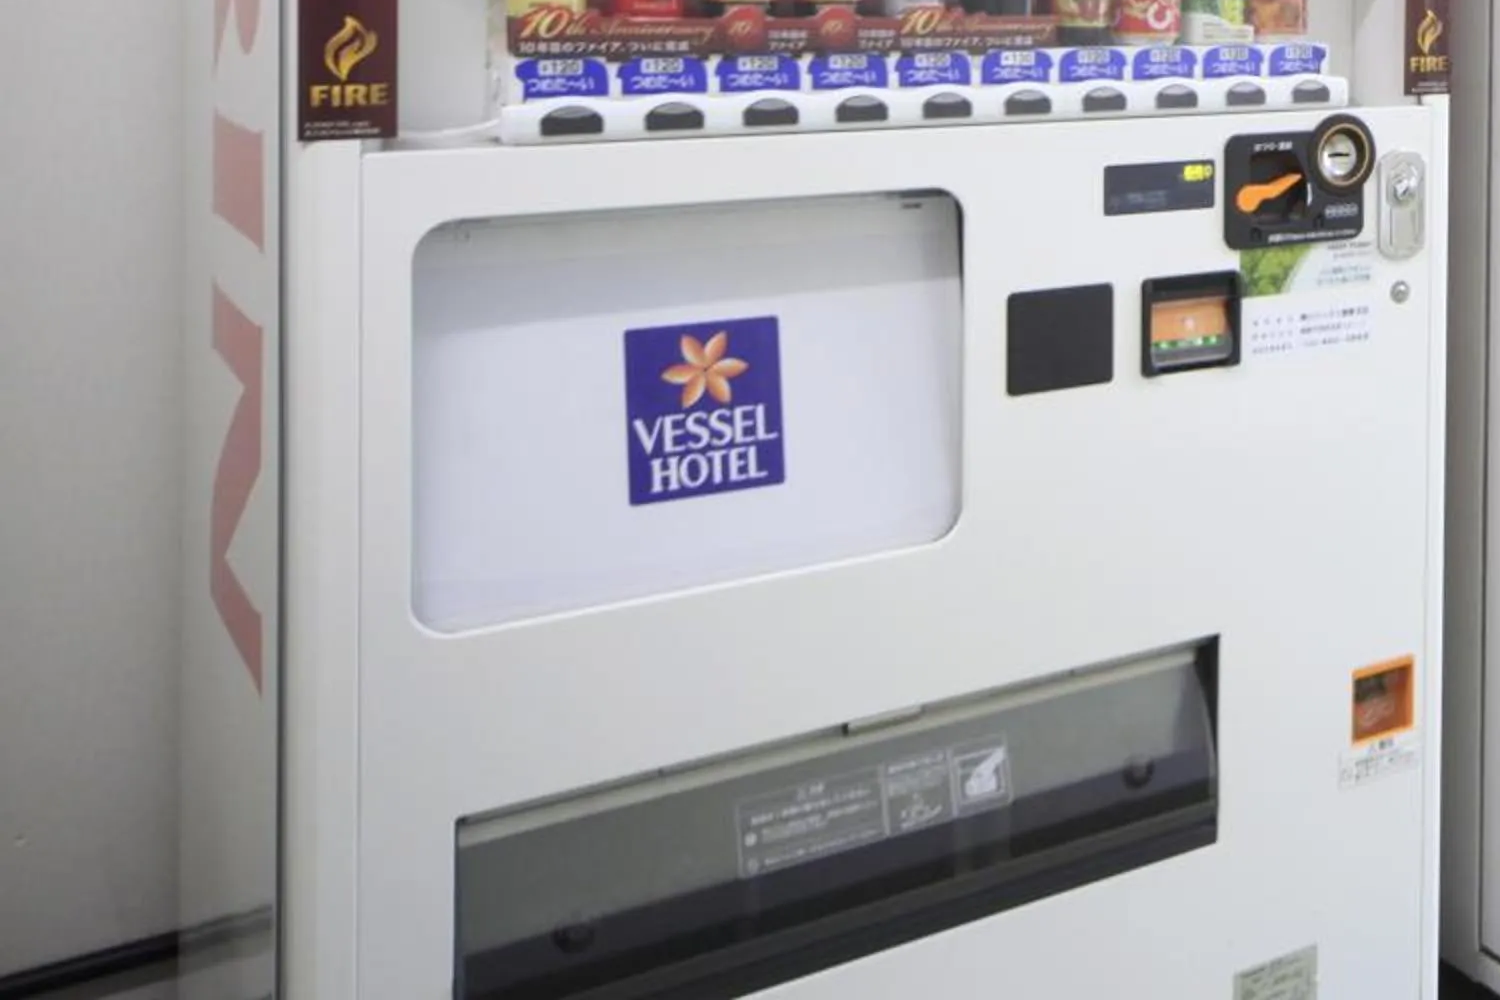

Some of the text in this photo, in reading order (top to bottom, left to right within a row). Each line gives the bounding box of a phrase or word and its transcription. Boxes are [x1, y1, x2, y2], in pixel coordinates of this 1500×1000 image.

[1409, 54, 1449, 74] FIRE
[309, 83, 390, 109] FIRE
[632, 402, 779, 456] VESSEL
[648, 445, 769, 494] HOTEL
